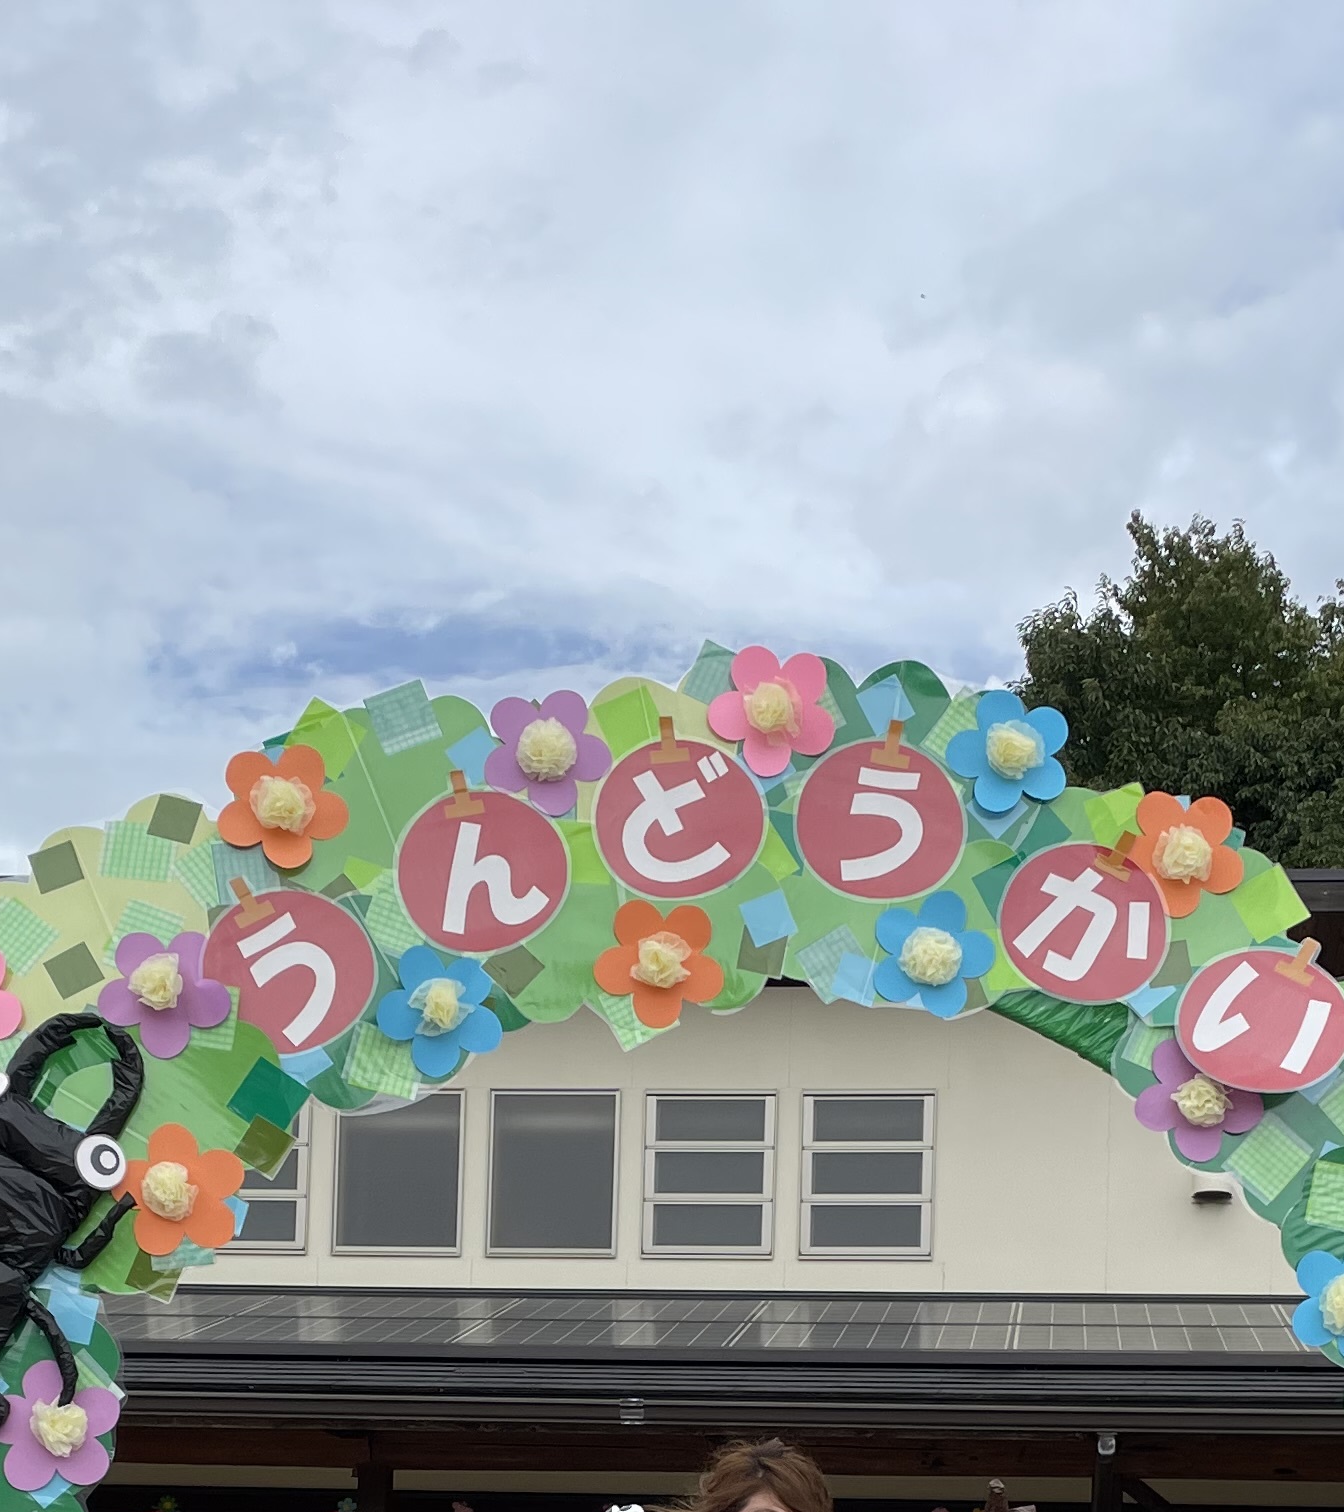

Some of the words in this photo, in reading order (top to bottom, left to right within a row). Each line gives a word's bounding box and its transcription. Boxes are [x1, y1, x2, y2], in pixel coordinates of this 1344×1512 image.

[236, 749, 1332, 1075] うんどうかい
